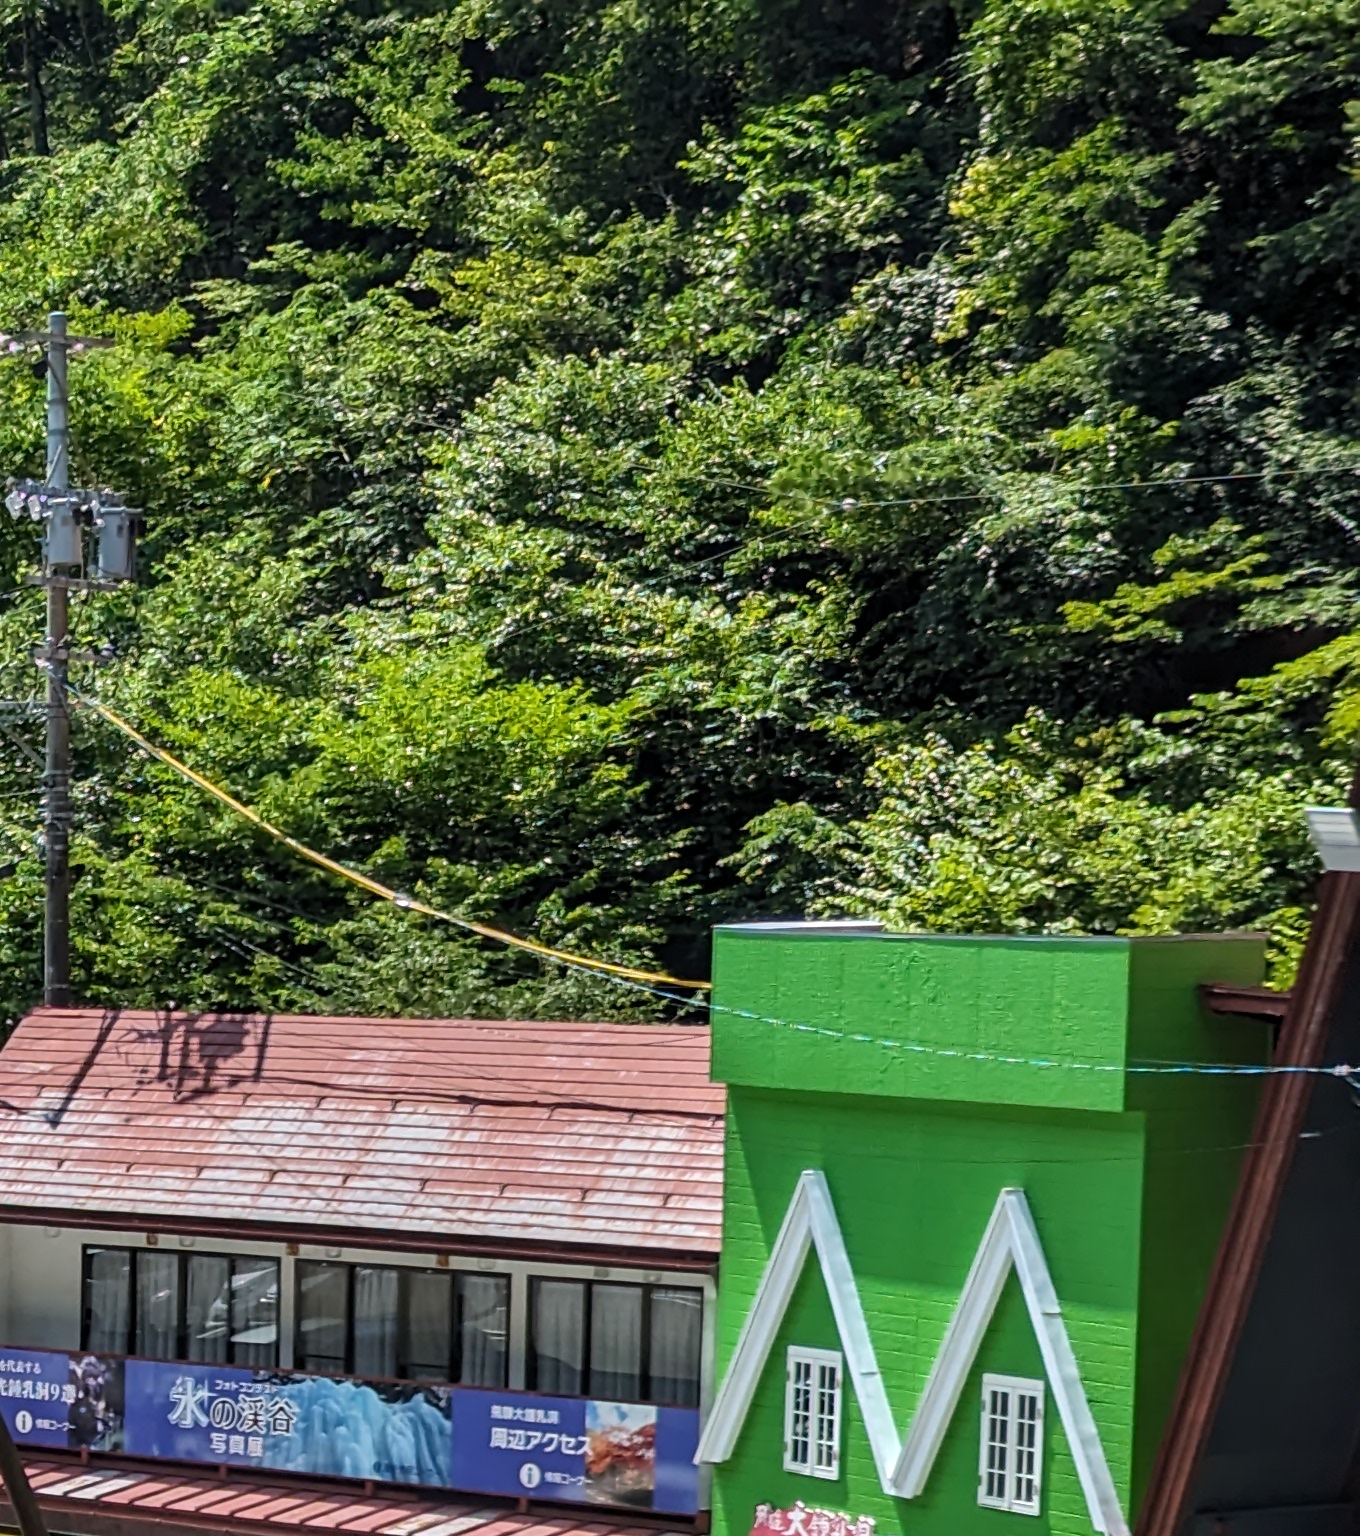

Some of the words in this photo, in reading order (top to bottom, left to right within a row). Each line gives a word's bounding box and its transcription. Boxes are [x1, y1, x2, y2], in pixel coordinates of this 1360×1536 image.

[214, 1378, 279, 1394] フォトコンテスト
[167, 1375, 299, 1438] 氷の渓谷
[489, 1427, 594, 1456] 周辺アクセス
